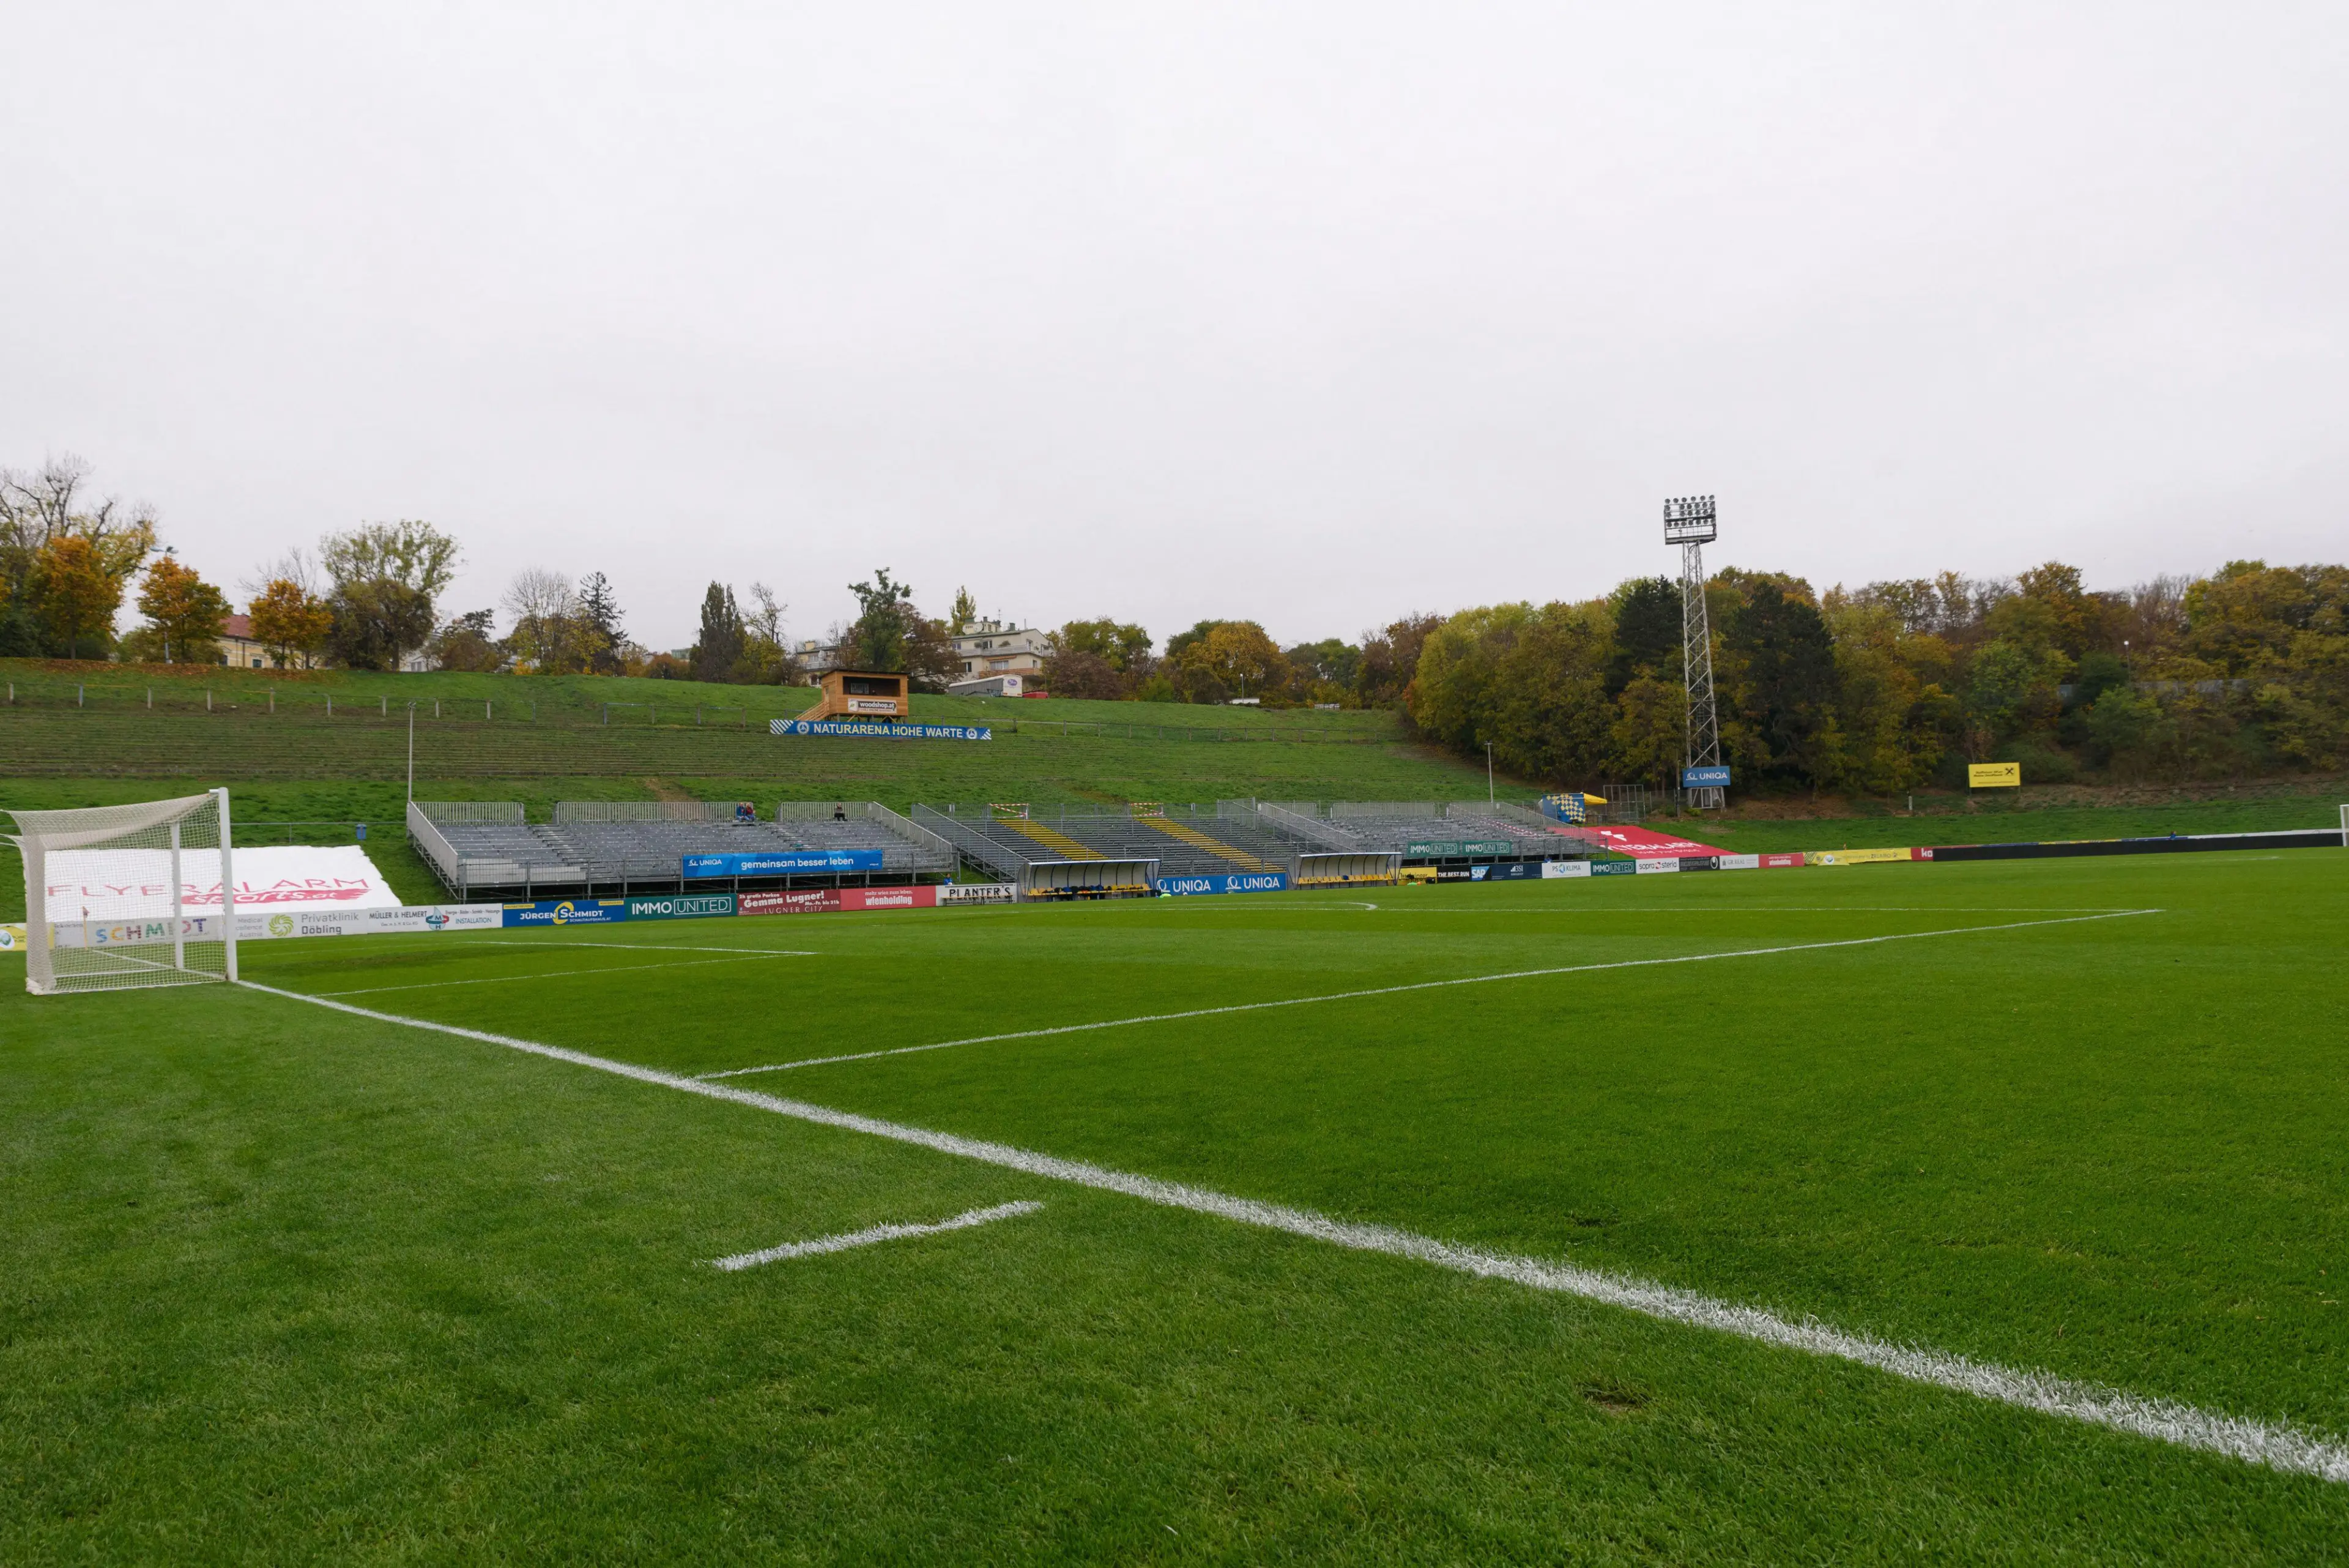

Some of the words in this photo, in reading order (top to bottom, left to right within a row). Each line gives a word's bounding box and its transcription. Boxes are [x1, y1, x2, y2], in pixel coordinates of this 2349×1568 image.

[814, 723, 889, 735] NATURARENA
[892, 726, 922, 737] HOHE
[926, 727, 963, 738] WARTE
[1699, 771, 1727, 780] UNIQA
[1410, 844, 1430, 853] IMMO
[1431, 844, 1456, 853] UNITED
[1465, 844, 1483, 852] IMMO
[1484, 843, 1508, 852] UNITED
[741, 860, 795, 871] gemeinsam
[797, 858, 828, 867] besser
[829, 856, 854, 866] leben
[1592, 864, 1609, 872] IMMO
[1611, 863, 1633, 872] UNITED
[1661, 860, 1677, 869] steria
[1471, 869, 1486, 879] SAP
[1173, 880, 1211, 893] UNIQA
[1243, 877, 1280, 889] UNIQA
[949, 885, 1011, 901] PLANTER'S
[743, 897, 784, 908] Gemma
[786, 890, 825, 904] Lugner!
[866, 895, 913, 905] wienholding
[632, 901, 672, 915] IMMO
[677, 899, 728, 913] UNITED
[765, 906, 800, 915] LUGNER
[301, 912, 360, 923] Privatklinik
[369, 910, 392, 920] MÜLLER
[520, 912, 556, 920] JÜRGEN
[560, 908, 604, 918] SCHMIDT
[95, 917, 207, 944] SCHMIDT
[302, 925, 342, 935] Döbling
